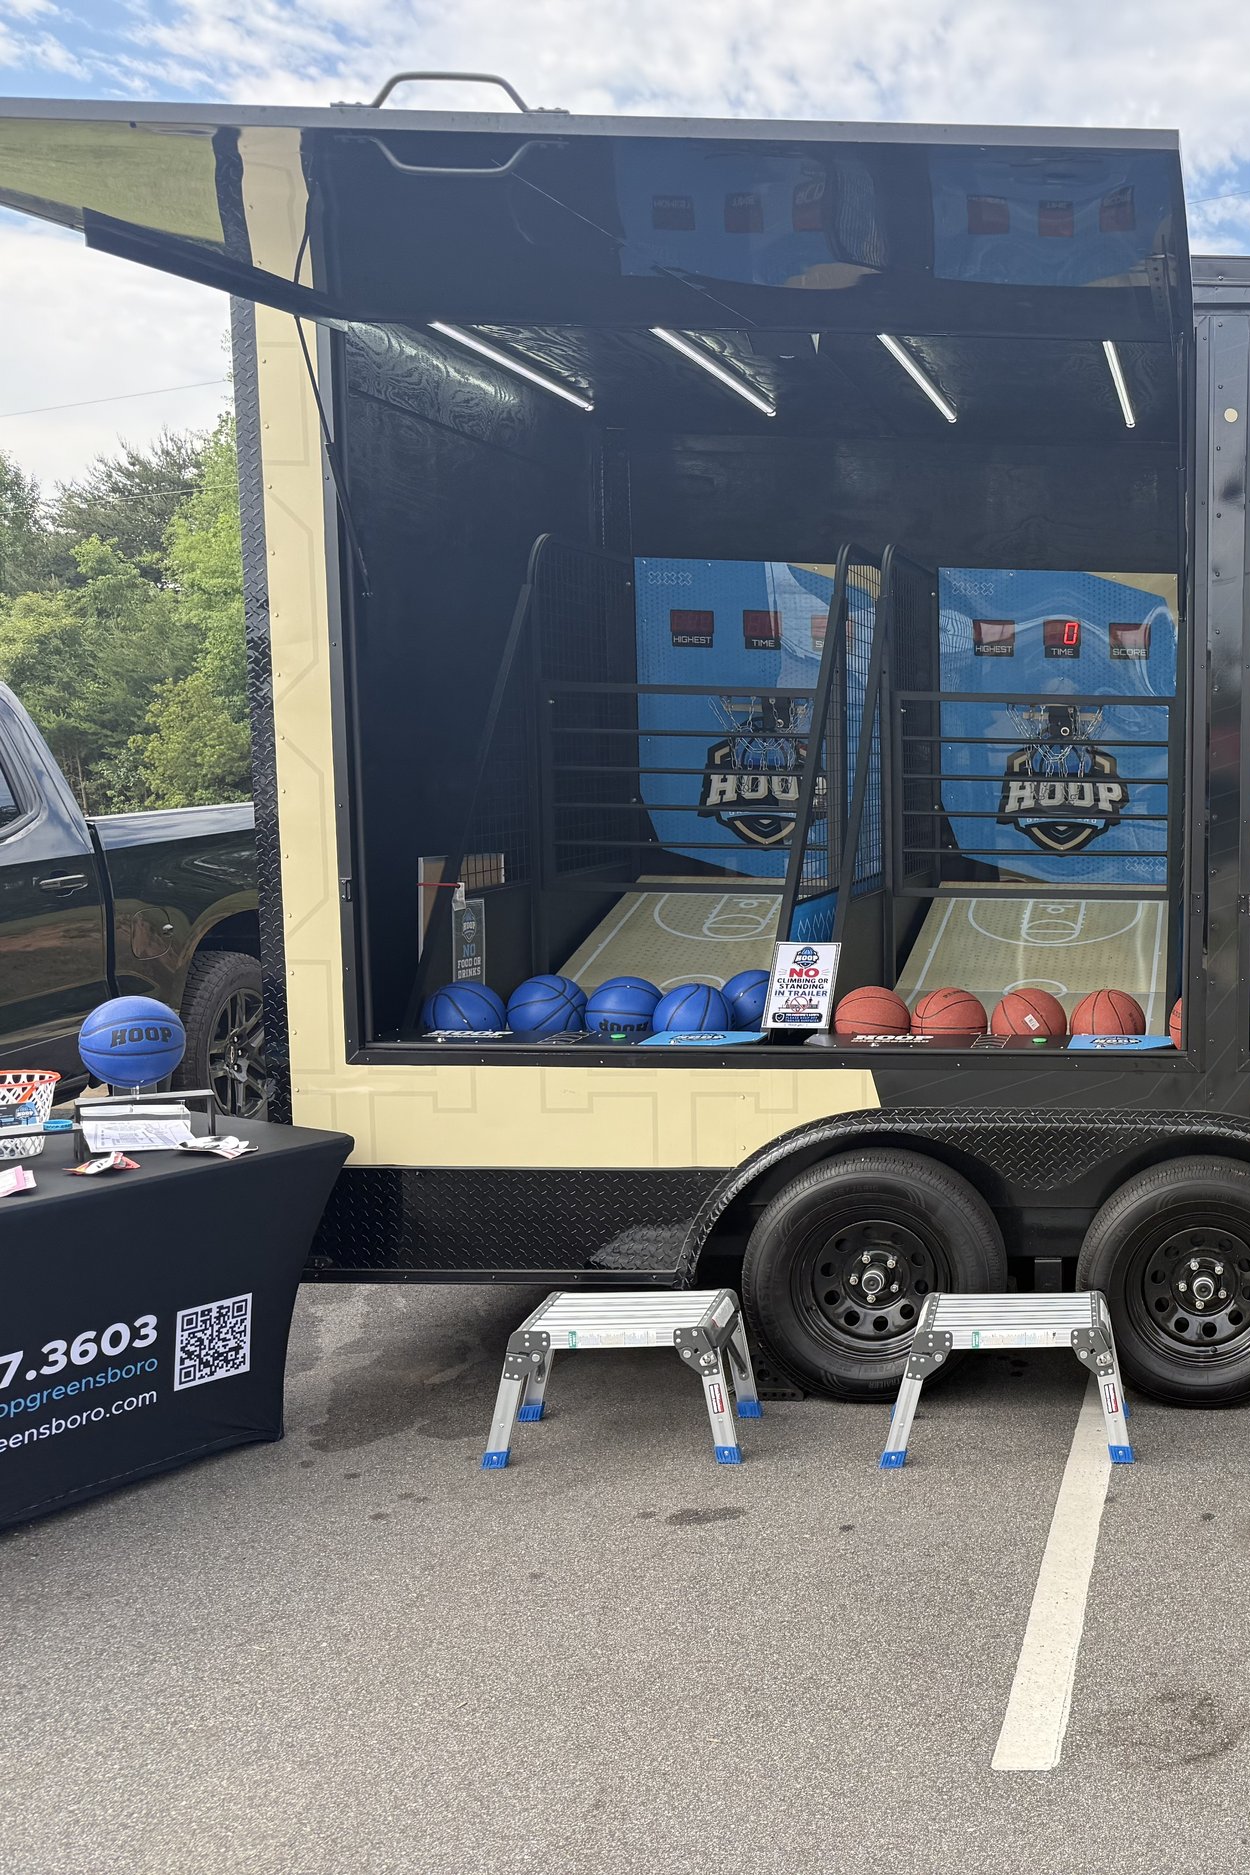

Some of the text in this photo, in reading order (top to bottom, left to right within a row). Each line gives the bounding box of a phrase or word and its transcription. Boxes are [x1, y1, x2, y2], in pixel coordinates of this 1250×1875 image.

[1063, 622, 1079, 645] 0
[673, 635, 711, 644] HIGHEST
[752, 639, 775, 647] TIME
[975, 645, 1013, 653] HIGHEST
[1051, 648, 1074, 656] TIME
[1112, 648, 1147, 657] SCORE
[1005, 780, 1122, 813] HOOP
[463, 943, 476, 957] NO
[457, 959, 473, 969] FOOD
[457, 967, 481, 979] DRINKS
[789, 968, 819, 978] NO
[109, 1026, 173, 1048] HOOP
